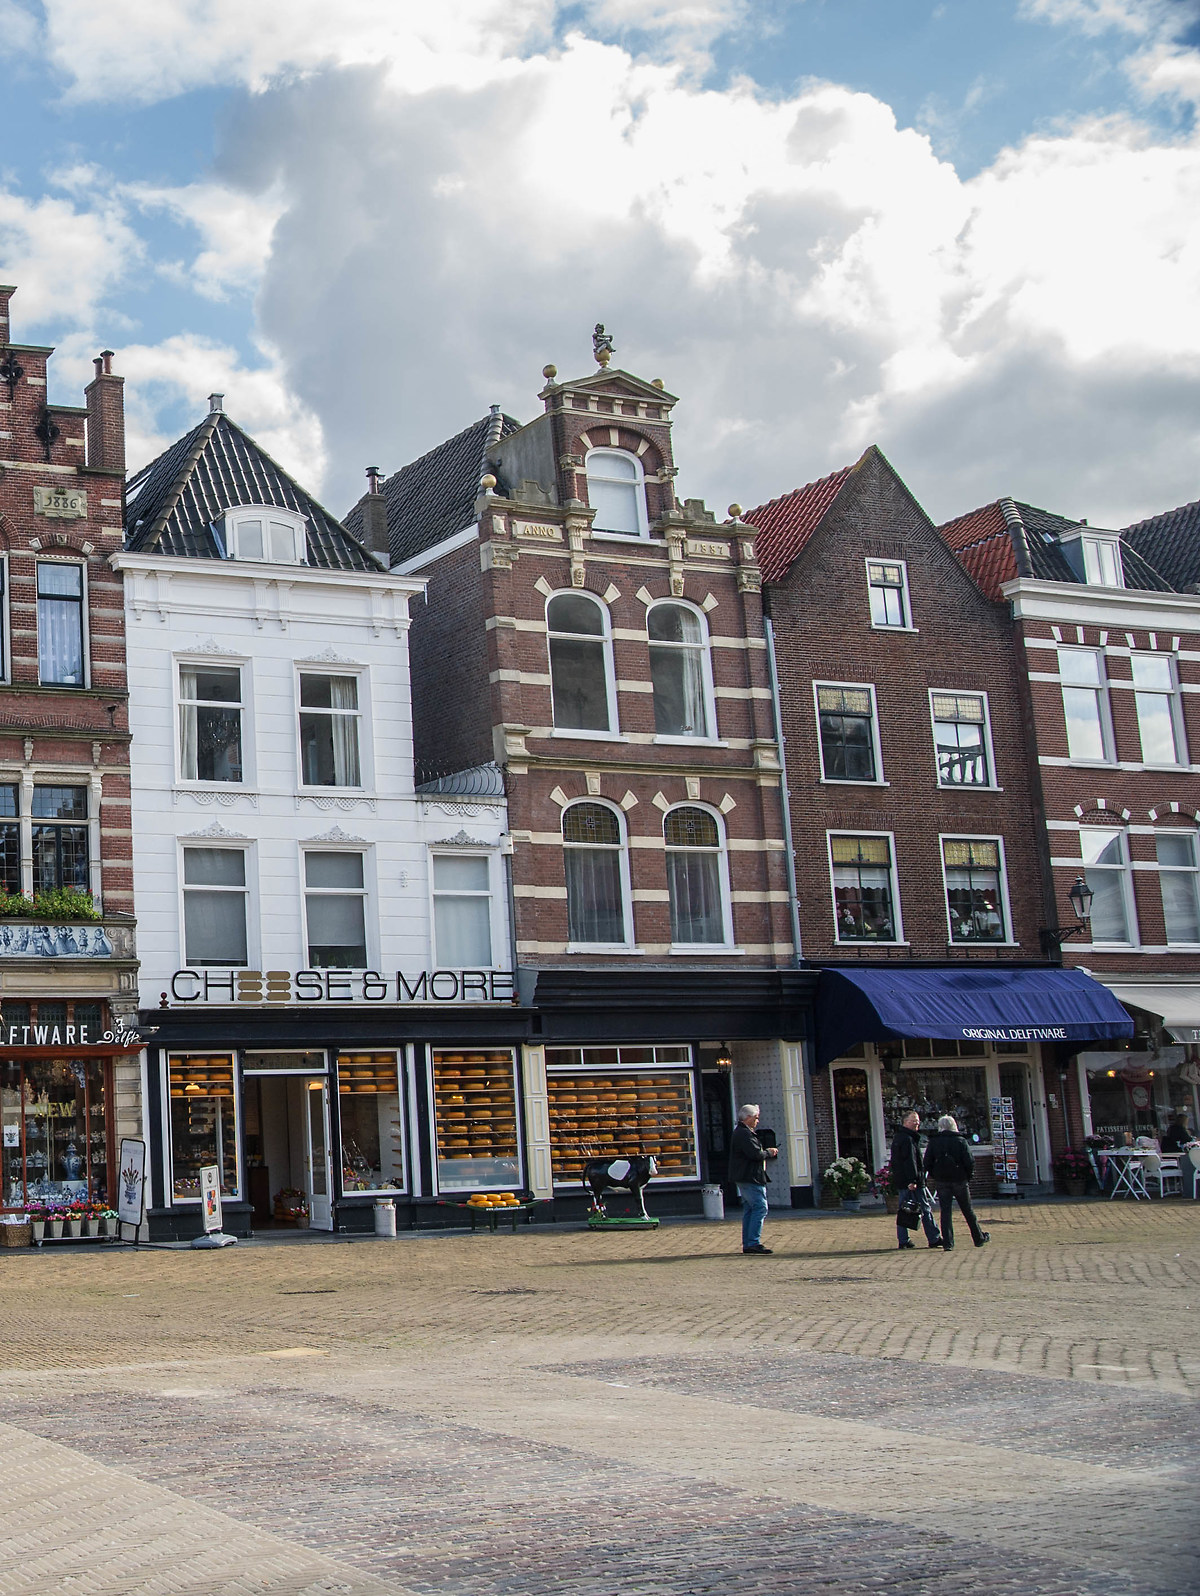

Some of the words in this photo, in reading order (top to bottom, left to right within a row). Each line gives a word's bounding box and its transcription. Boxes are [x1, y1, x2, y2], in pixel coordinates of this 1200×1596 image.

[524, 525, 555, 537] ANNO
[362, 970, 388, 1001] &
[396, 970, 515, 1001] MORE
[962, 1028, 1009, 1040] ORIGINAL
[1009, 1028, 1067, 1039] DELFTWARE
[35, 1100, 77, 1118] NEW
